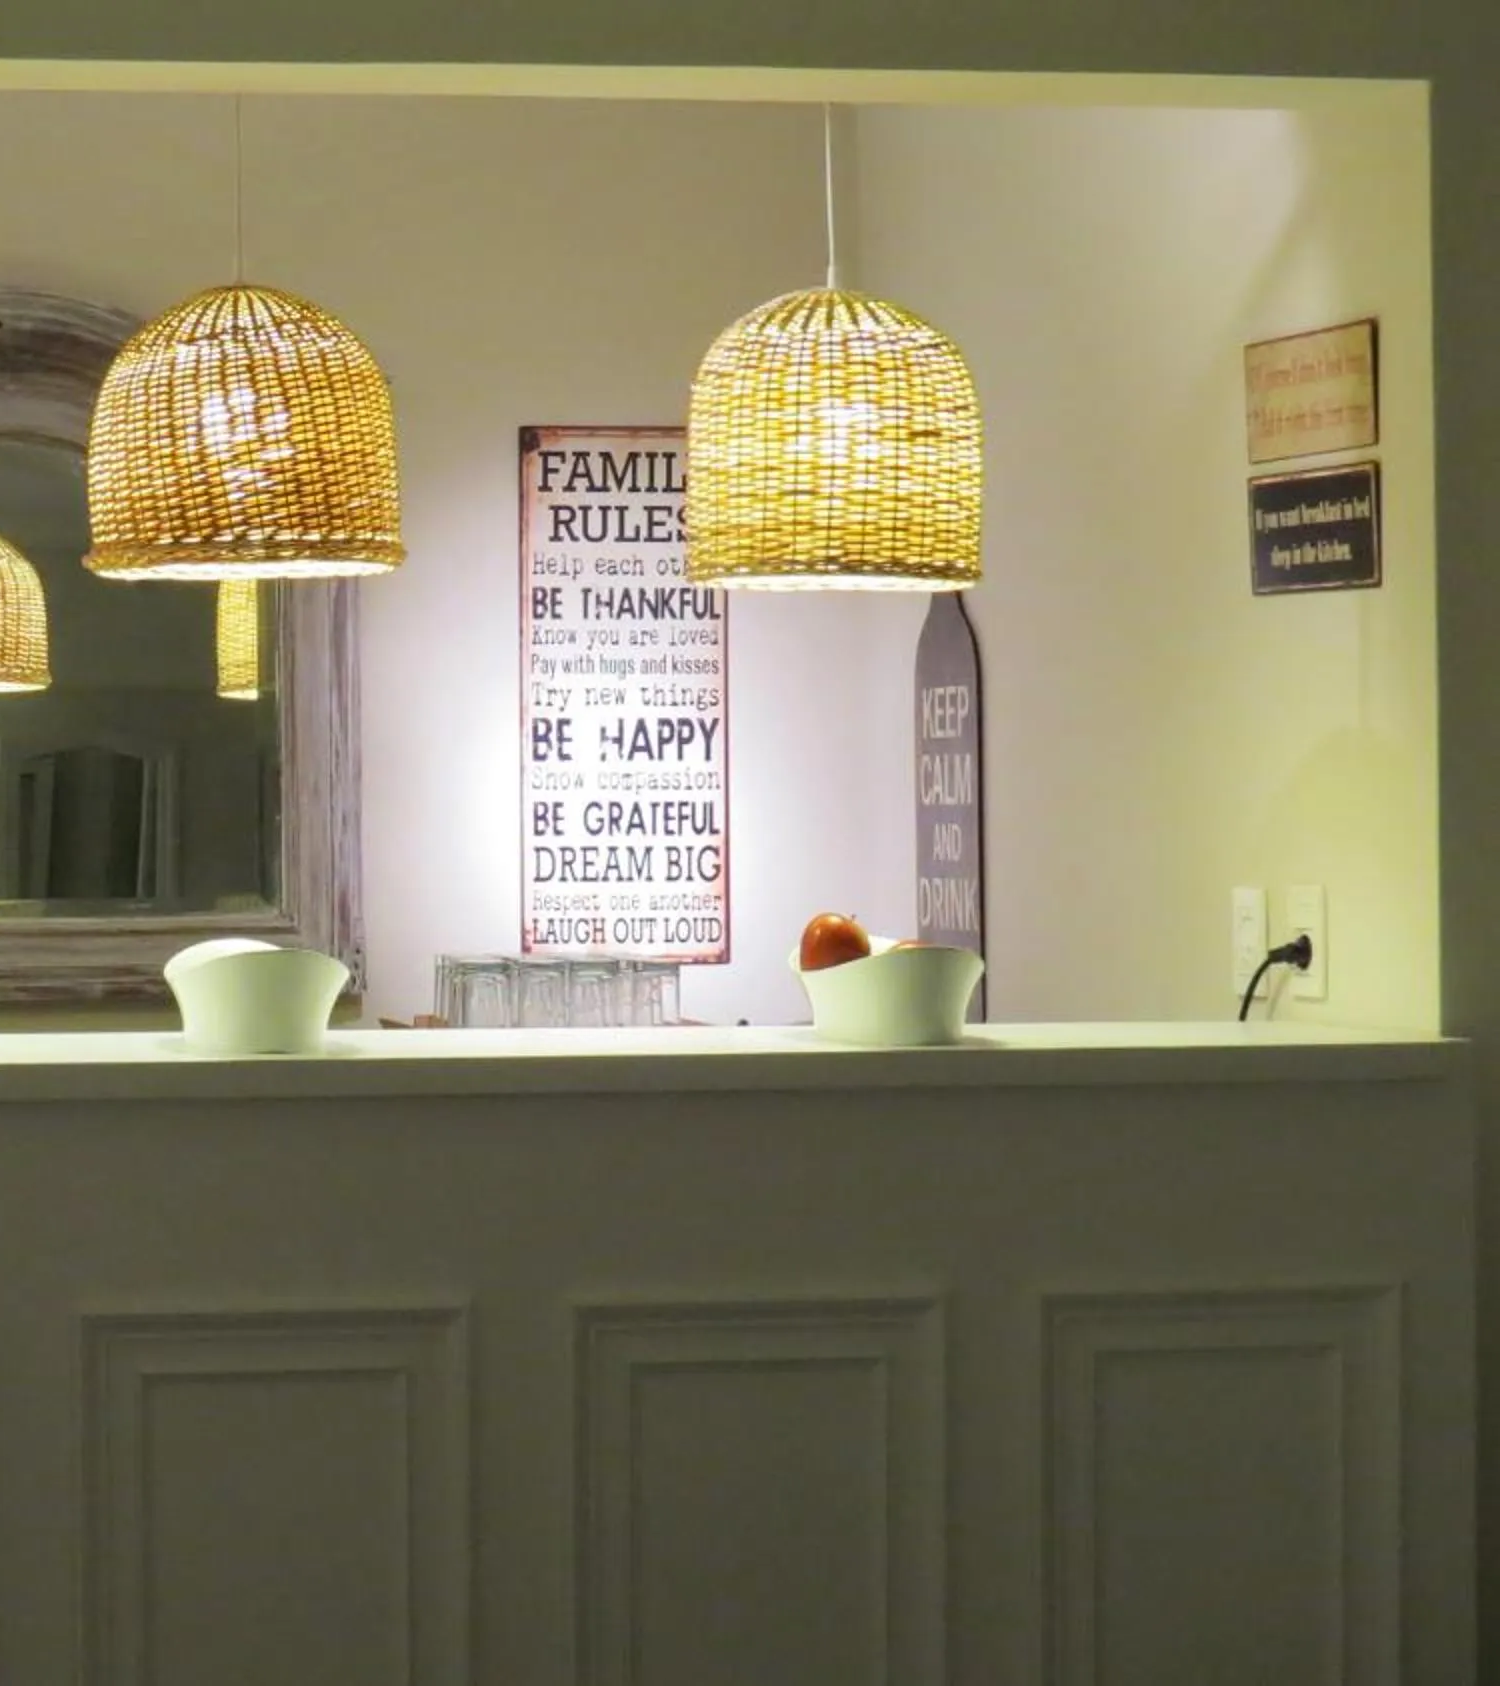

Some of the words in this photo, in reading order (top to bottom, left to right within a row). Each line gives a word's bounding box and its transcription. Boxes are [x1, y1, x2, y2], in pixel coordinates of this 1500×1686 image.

[537, 451, 688, 493] FAMIL
[532, 552, 584, 580] Help
[595, 554, 645, 576] each
[532, 586, 563, 620] BE
[581, 587, 721, 621] THANKFUL
[531, 625, 577, 646] Know
[587, 627, 620, 651] you
[629, 630, 660, 646] are
[668, 626, 719, 647] loved
[531, 653, 557, 680] Pay
[561, 655, 595, 675] with
[600, 654, 635, 679] hugs
[640, 654, 667, 675] and
[671, 654, 720, 675] kisses
[531, 683, 572, 712] Try
[585, 686, 626, 706] new
[640, 684, 720, 711] things
[923, 685, 969, 739] KEEP
[532, 717, 573, 762] BE
[599, 717, 720, 762] HAPPY
[597, 767, 721, 795] compassion
[921, 753, 971, 805] CALM
[533, 801, 565, 837] BE
[583, 801, 720, 837] GRATEFUL
[933, 823, 962, 861] AND
[533, 846, 654, 882] DREAM
[665, 845, 721, 882] BIG
[531, 890, 601, 915] Respect
[609, 894, 641, 911] one
[649, 892, 722, 911] another
[920, 877, 979, 934] DRINK
[532, 917, 606, 944] LAUGH
[613, 917, 657, 944] OUT
[663, 917, 723, 944] LOUD
